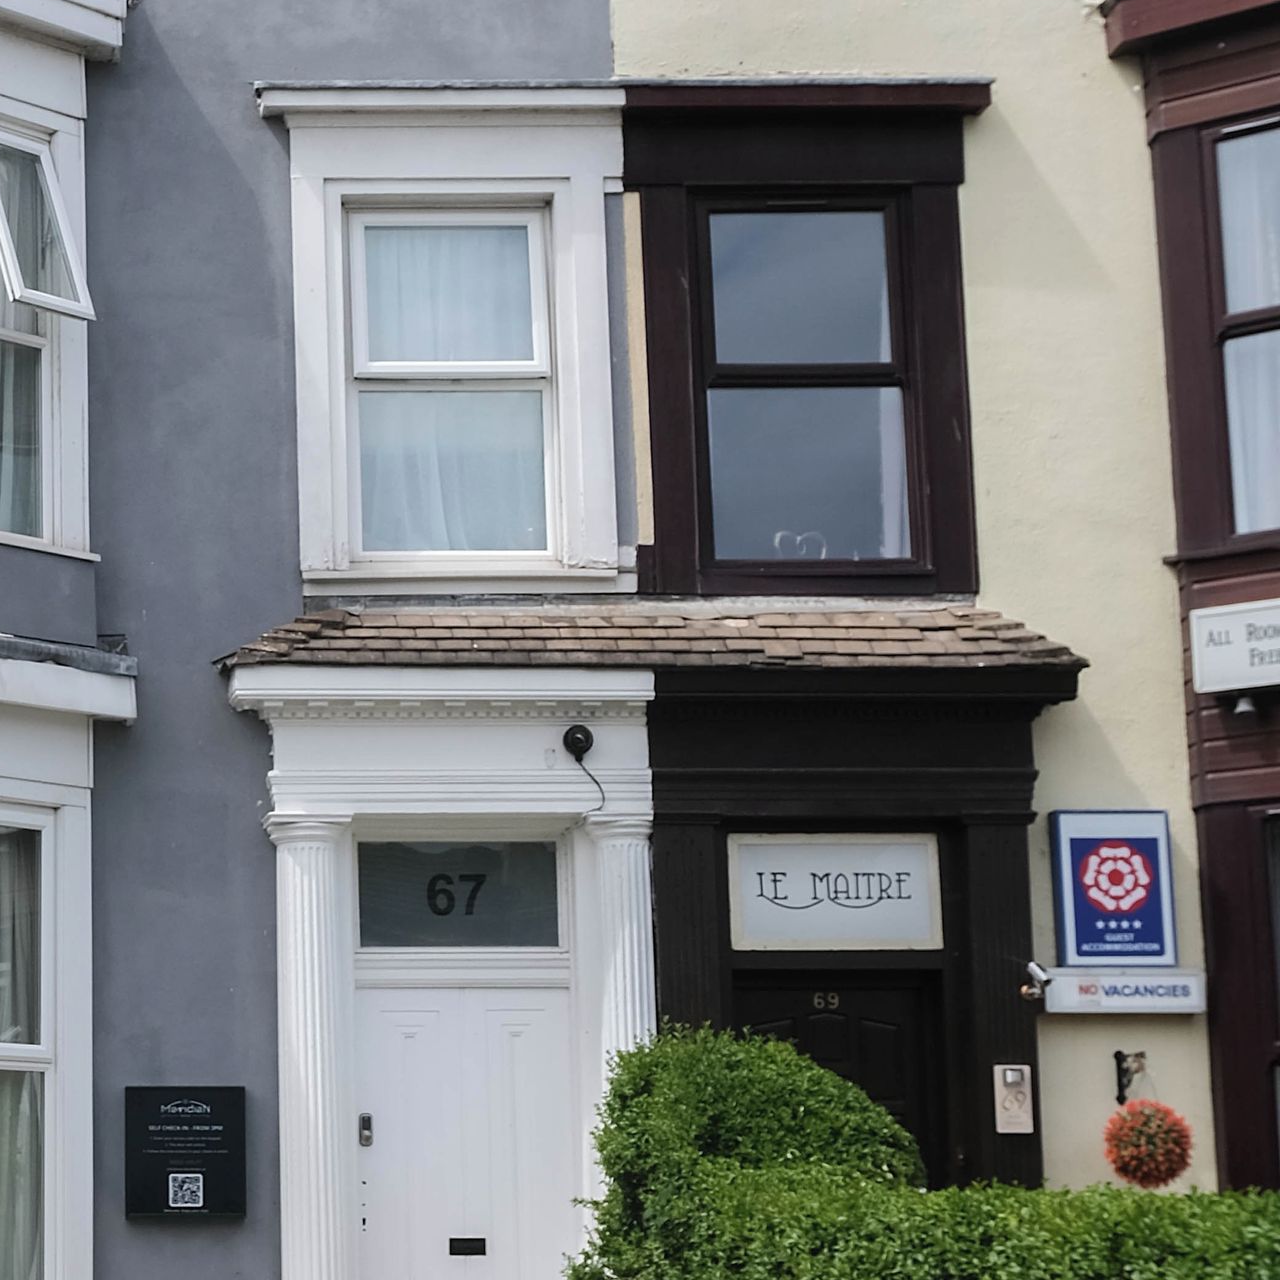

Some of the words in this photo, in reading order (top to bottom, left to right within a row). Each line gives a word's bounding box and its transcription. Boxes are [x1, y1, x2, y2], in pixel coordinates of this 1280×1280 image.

[426, 873, 487, 917] 67
[756, 872, 795, 905] LE
[810, 872, 913, 907] MAITRE
[1104, 932, 1135, 942] GUEST
[1078, 984, 1098, 996] NO
[1101, 983, 1192, 998] VACANCIES
[813, 992, 840, 1009] 69
